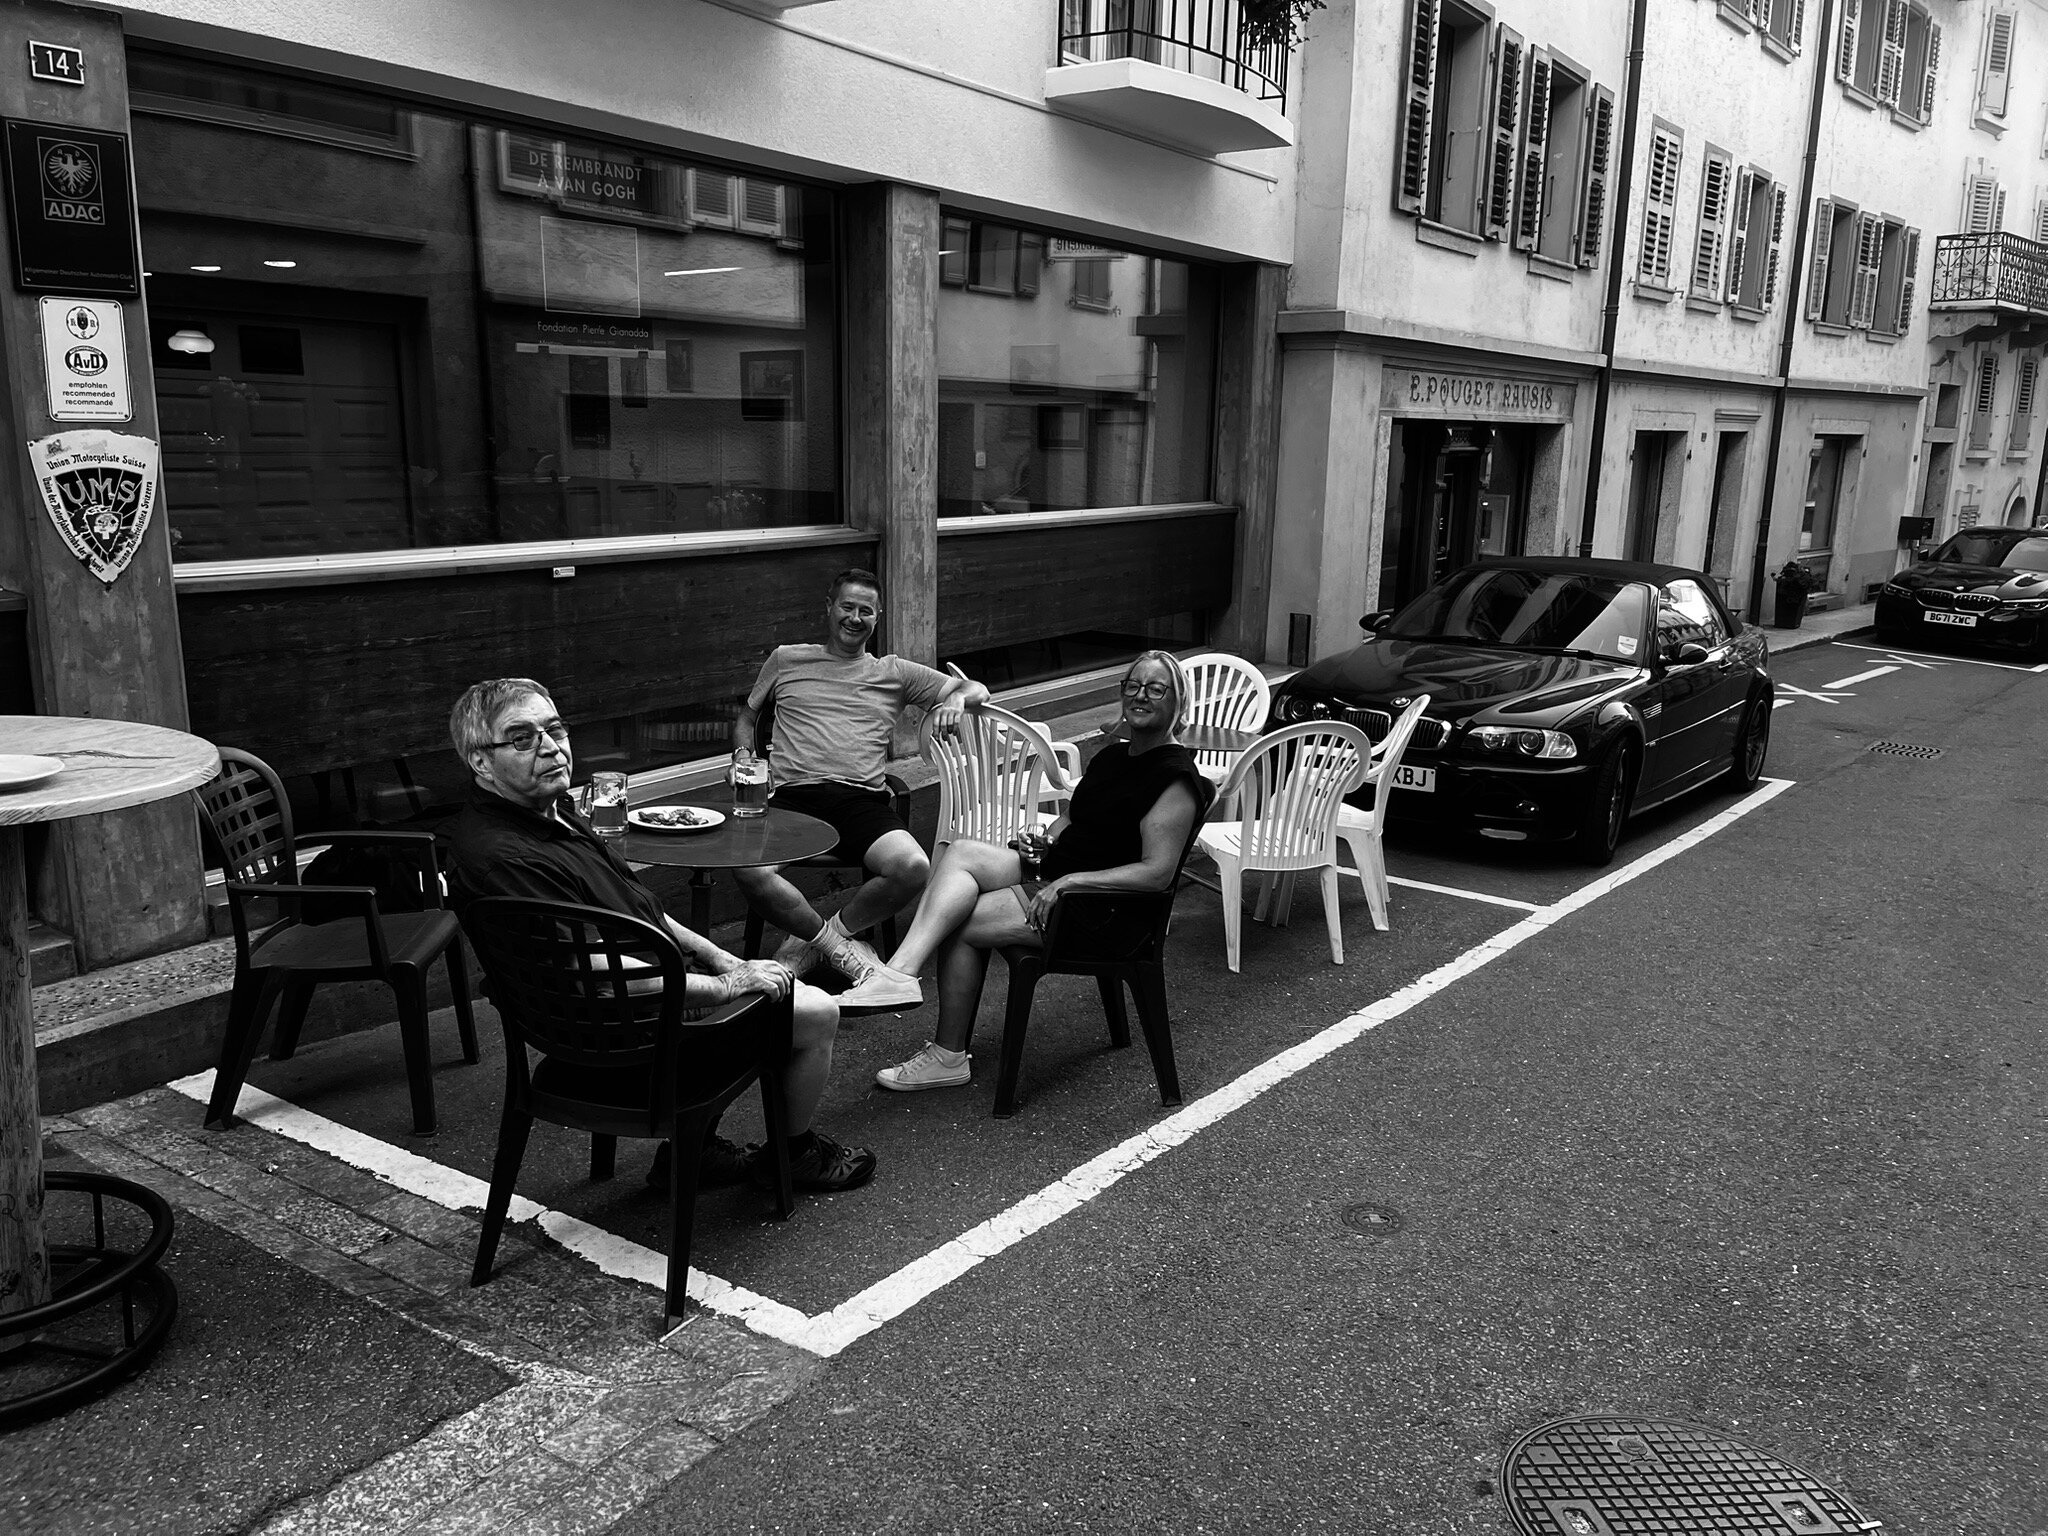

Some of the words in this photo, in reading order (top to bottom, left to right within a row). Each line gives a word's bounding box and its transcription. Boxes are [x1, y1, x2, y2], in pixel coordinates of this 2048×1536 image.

[45, 50, 70, 76] 14
[528, 150, 548, 169] DE
[554, 153, 643, 182] REMBRANDT
[537, 169, 549, 189] À
[553, 175, 586, 195] VAN
[592, 183, 637, 201] GOGH
[48, 202, 101, 221] ADAC
[537, 320, 579, 334] Fondation
[582, 323, 605, 336] Pierre
[609, 325, 649, 338] Gianadda
[73, 352, 101, 369] AvD
[62, 390, 116, 398] recommended
[1502, 383, 1553, 410] RAUSIS
[46, 458, 71, 470] Union
[70, 453, 120, 464] Motocycliste
[122, 455, 147, 469] Suisse
[63, 477, 136, 504] UMS
[1952, 615, 1971, 625] ZWC
